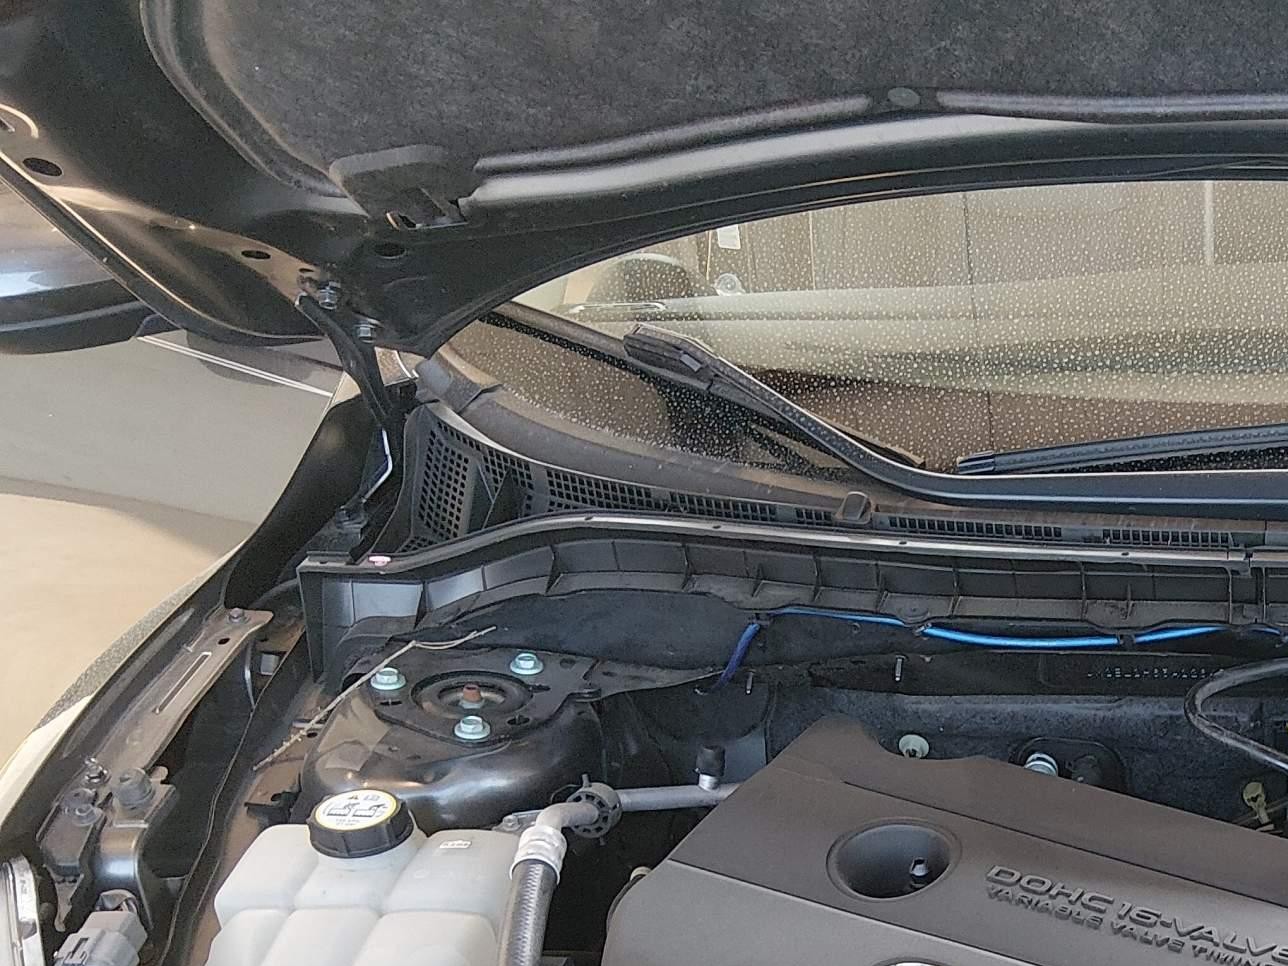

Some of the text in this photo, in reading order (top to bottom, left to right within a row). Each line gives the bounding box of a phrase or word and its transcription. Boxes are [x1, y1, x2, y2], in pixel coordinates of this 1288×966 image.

[985, 865, 1114, 913] DOHC
[988, 885, 1103, 930] VARIABLE
[1110, 919, 1184, 954] VALVE
